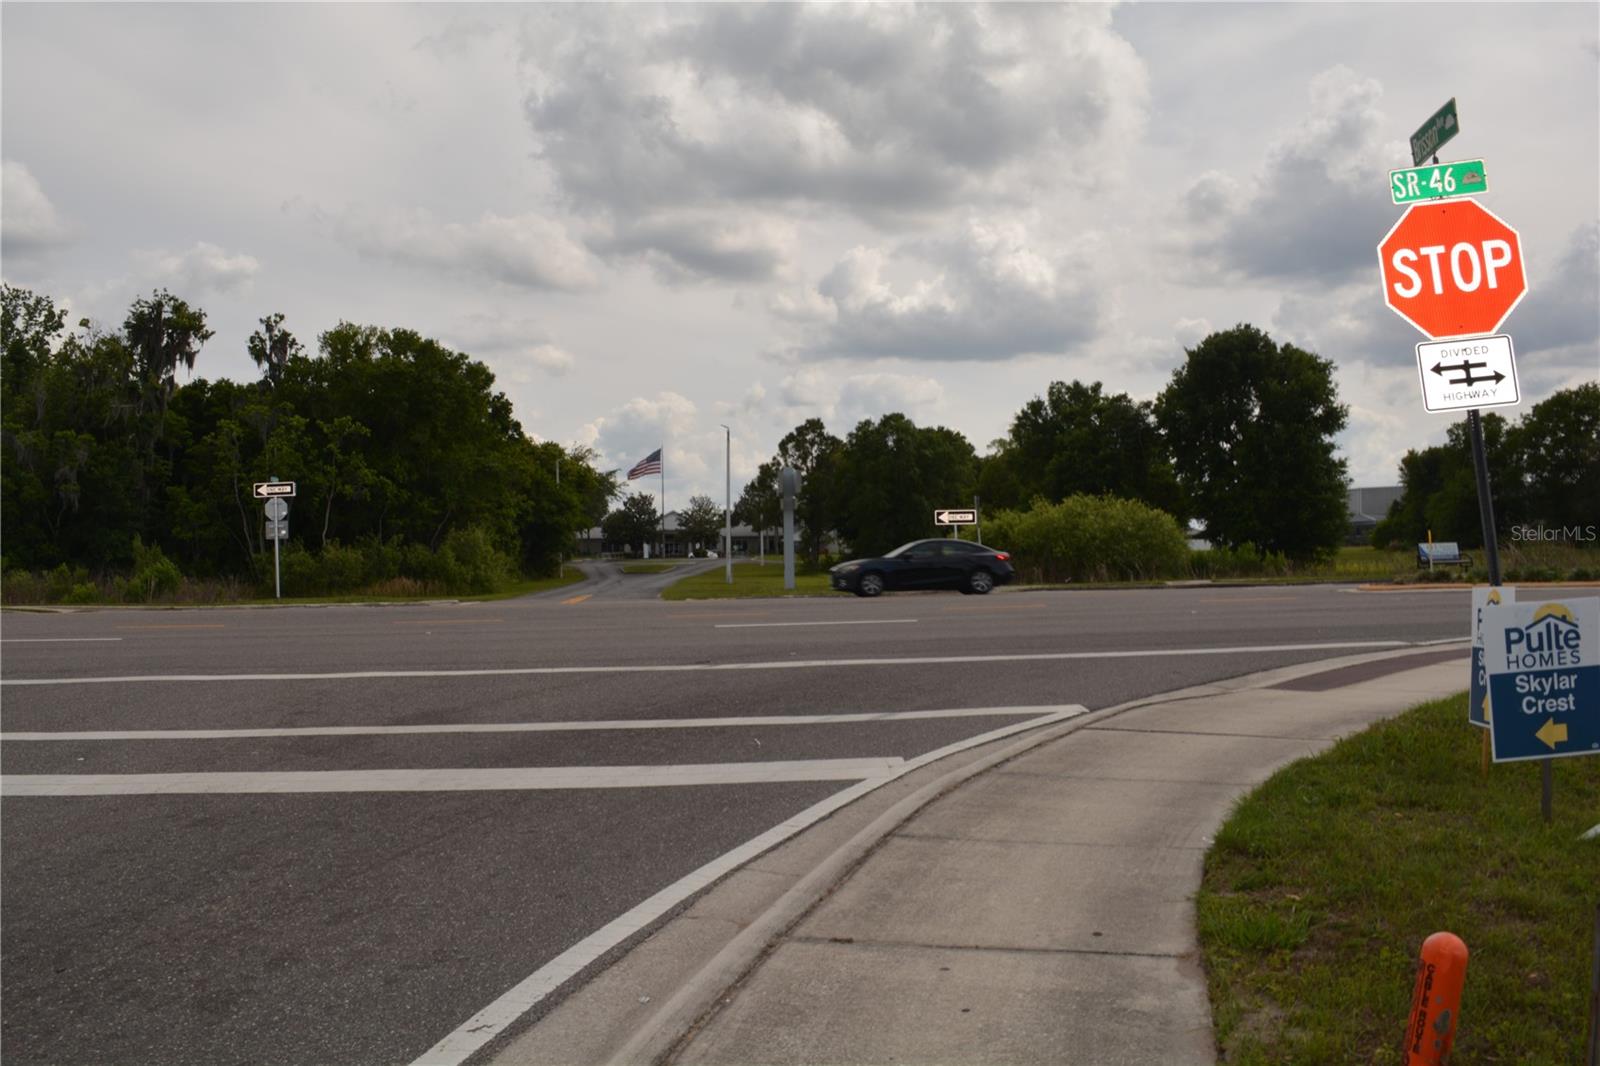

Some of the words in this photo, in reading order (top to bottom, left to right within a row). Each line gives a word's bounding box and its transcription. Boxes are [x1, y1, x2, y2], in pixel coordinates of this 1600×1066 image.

[1392, 239, 1512, 298] STOP
[1440, 345, 1489, 358] DIVIDED
[1443, 389, 1498, 401] HIGHWAY
[1504, 621, 1581, 654] Pulte
[1506, 650, 1581, 671] HOMES
[1515, 672, 1577, 696] Skylar
[1522, 694, 1576, 715] Crest
